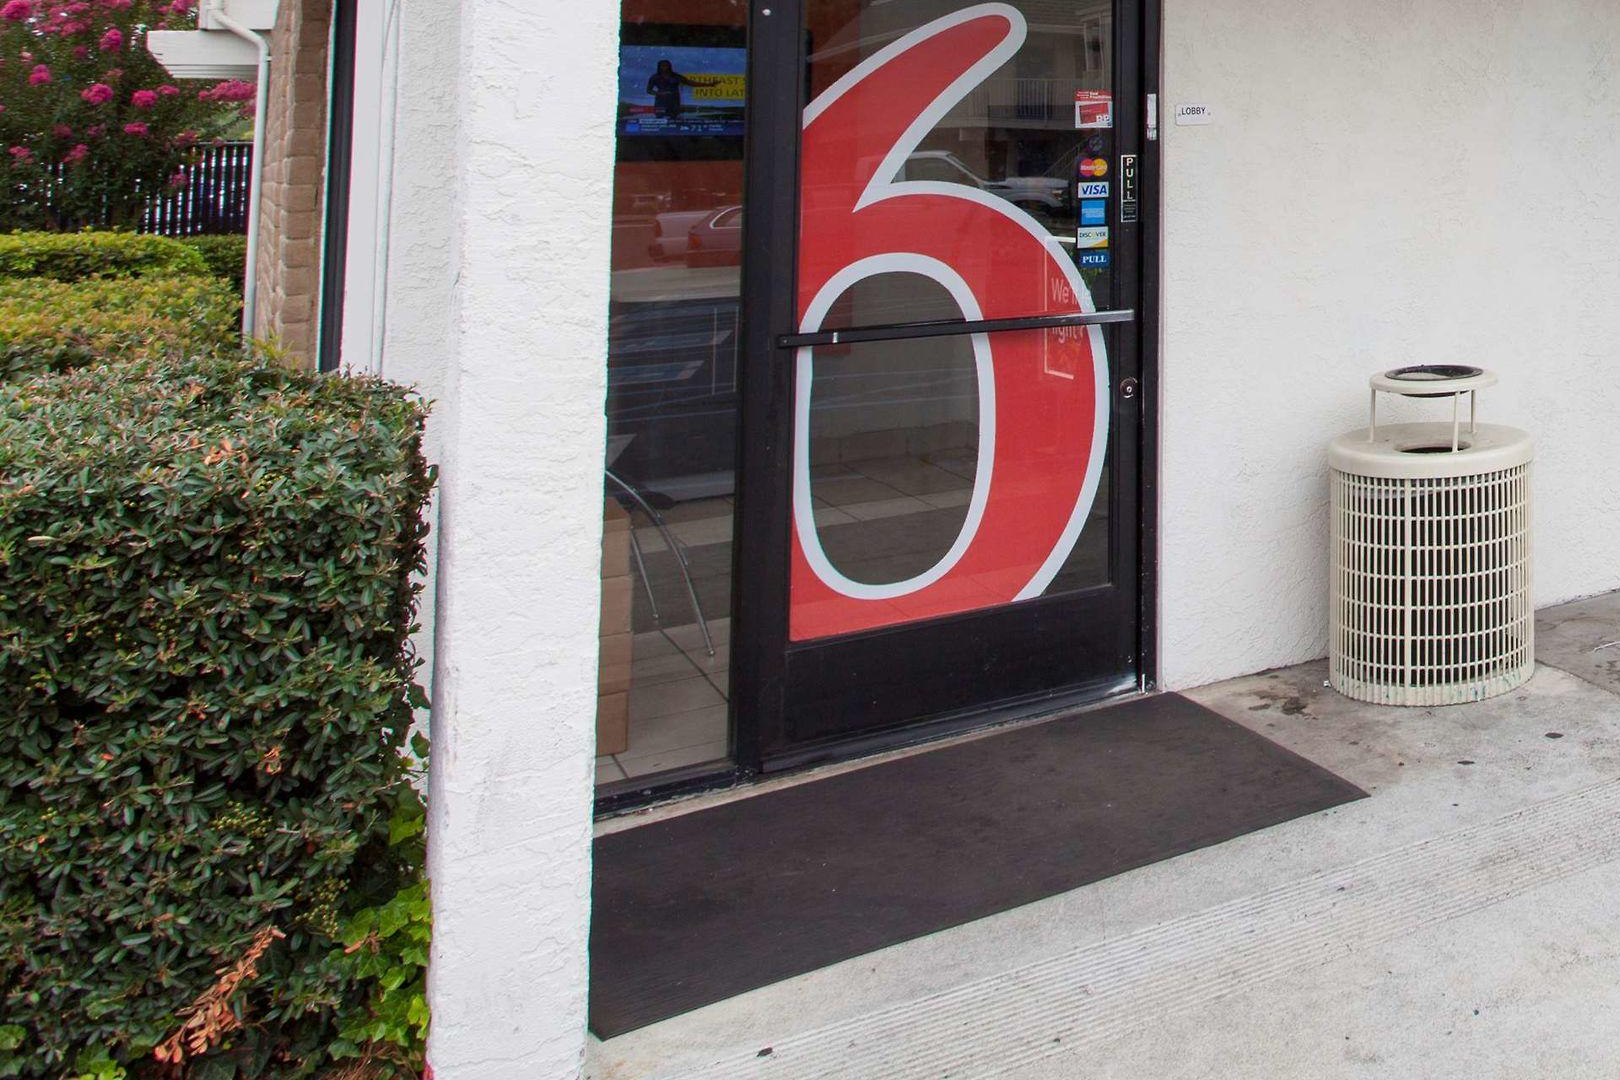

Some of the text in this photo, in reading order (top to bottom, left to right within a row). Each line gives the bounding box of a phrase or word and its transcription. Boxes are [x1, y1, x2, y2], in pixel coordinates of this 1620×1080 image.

[1181, 107, 1205, 115] LOBBY
[1126, 157, 1134, 199] PULL
[1082, 185, 1107, 195] VISA
[1082, 255, 1107, 263] PULL
[789, 2, 1110, 642] 6
